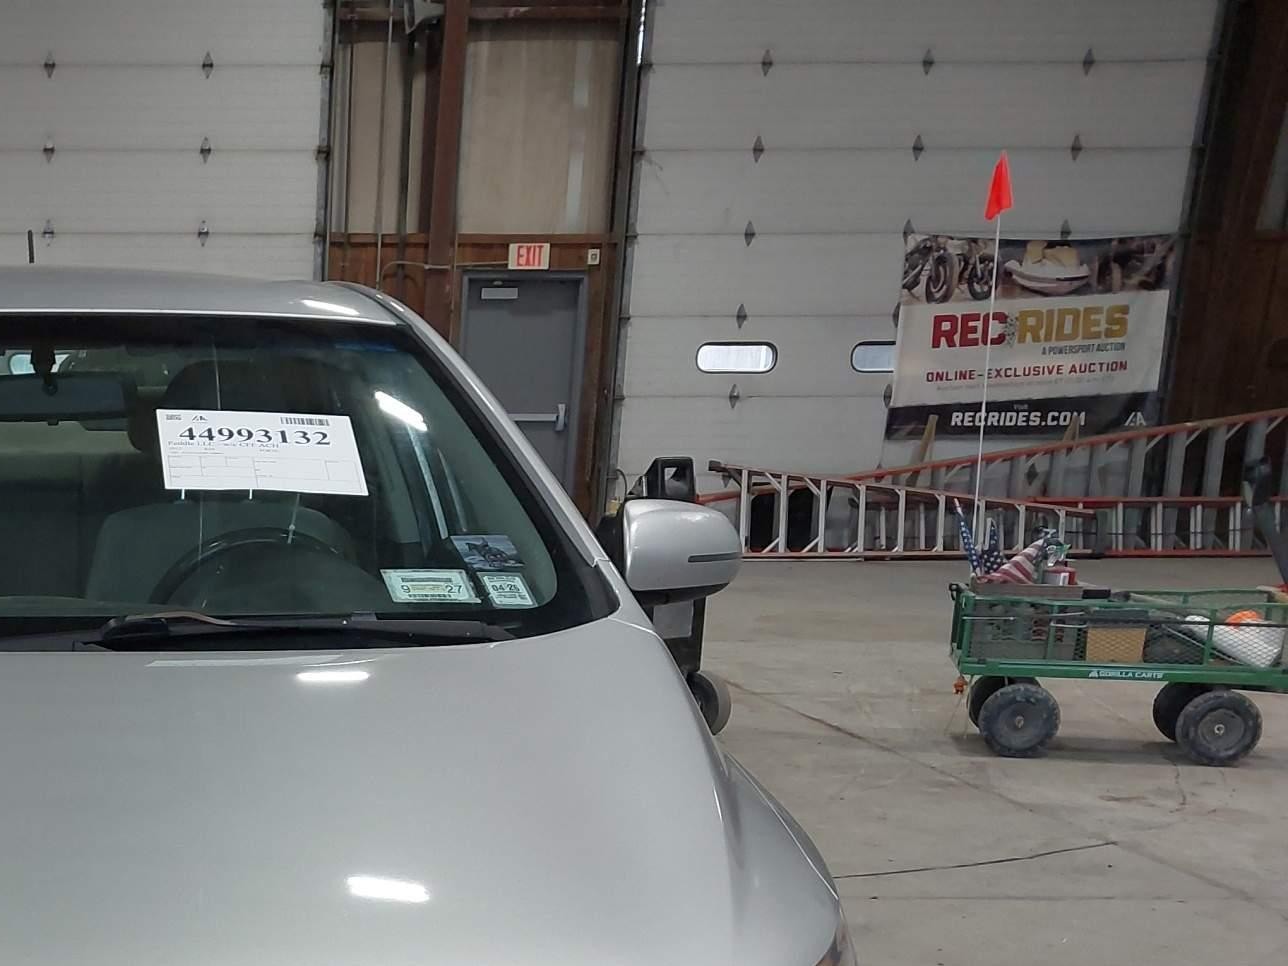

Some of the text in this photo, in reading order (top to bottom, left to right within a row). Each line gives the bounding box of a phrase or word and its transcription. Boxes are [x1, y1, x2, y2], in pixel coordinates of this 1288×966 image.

[516, 245, 544, 267] EXIT
[931, 304, 1130, 349] REC RIDES
[1041, 342, 1126, 355] A POWERSPORT AUCTION
[926, 360, 1128, 382] ONLINE-EXCLUSIVE AUCTION
[179, 426, 331, 446] 44993132
[400, 584, 411, 593] 9
[445, 584, 463, 594] 27
